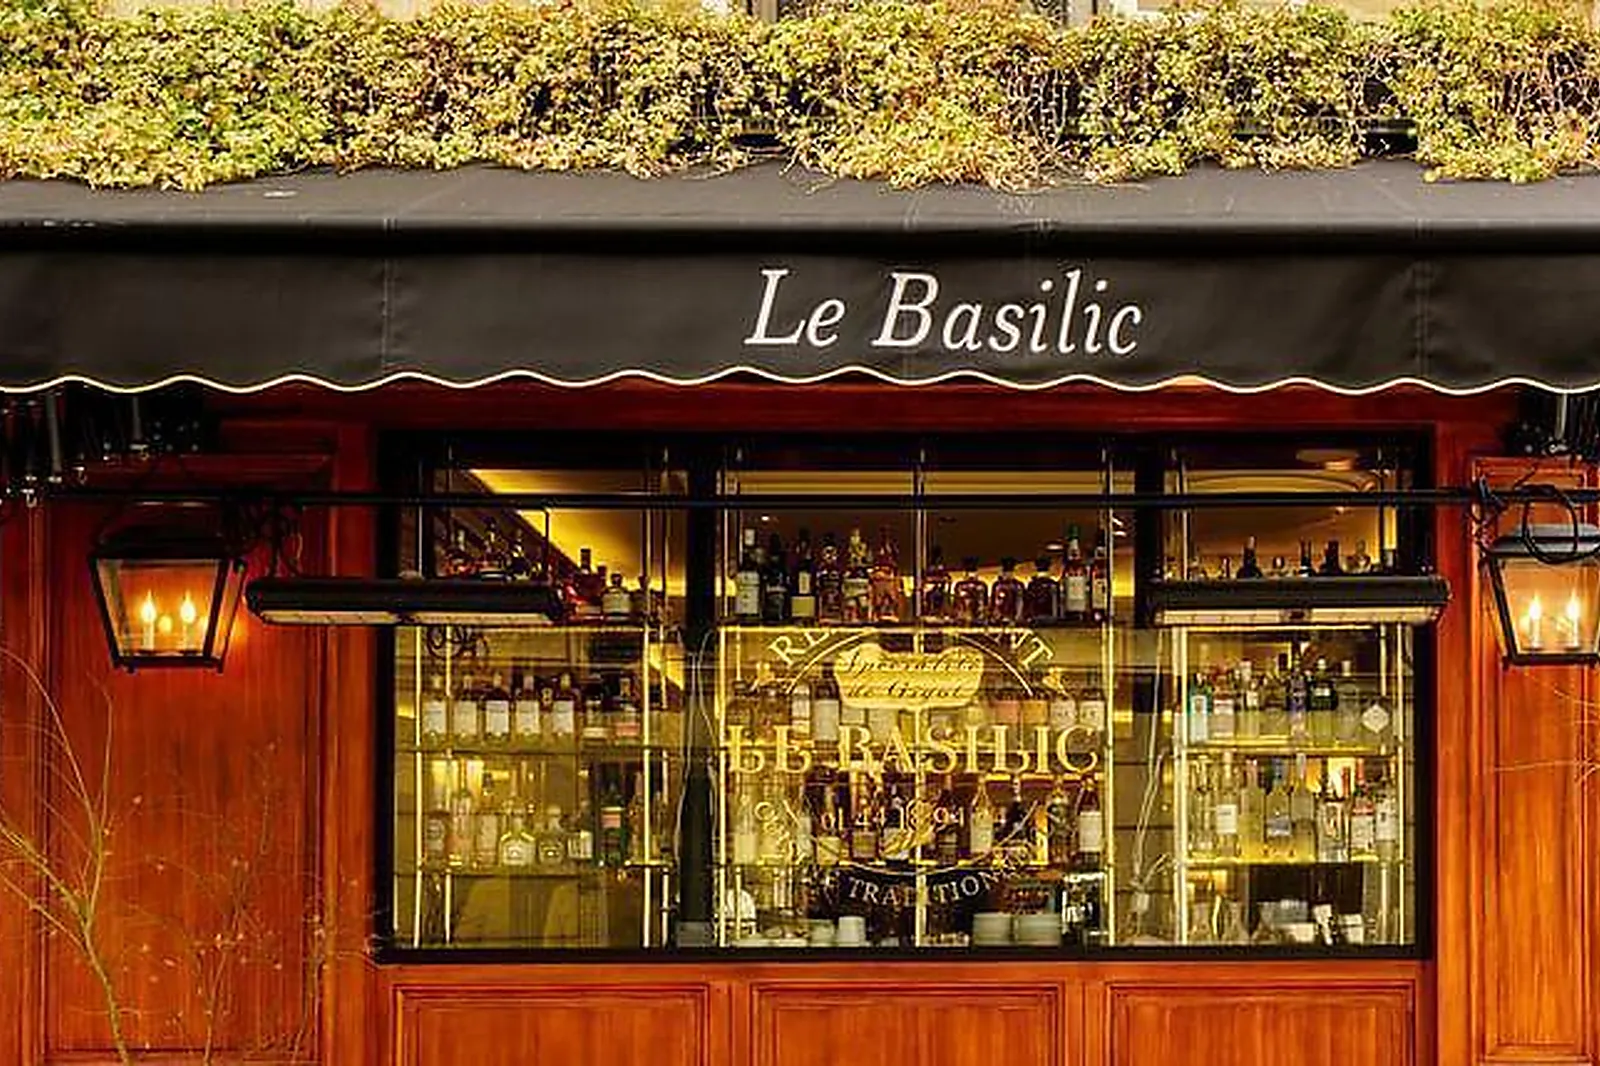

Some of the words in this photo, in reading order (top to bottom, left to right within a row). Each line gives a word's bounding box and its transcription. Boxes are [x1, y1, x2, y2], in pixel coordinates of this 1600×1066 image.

[744, 269, 846, 347] Le
[871, 269, 1142, 355] Basilic
[728, 724, 813, 774] LE
[838, 724, 1099, 774] BASILIC
